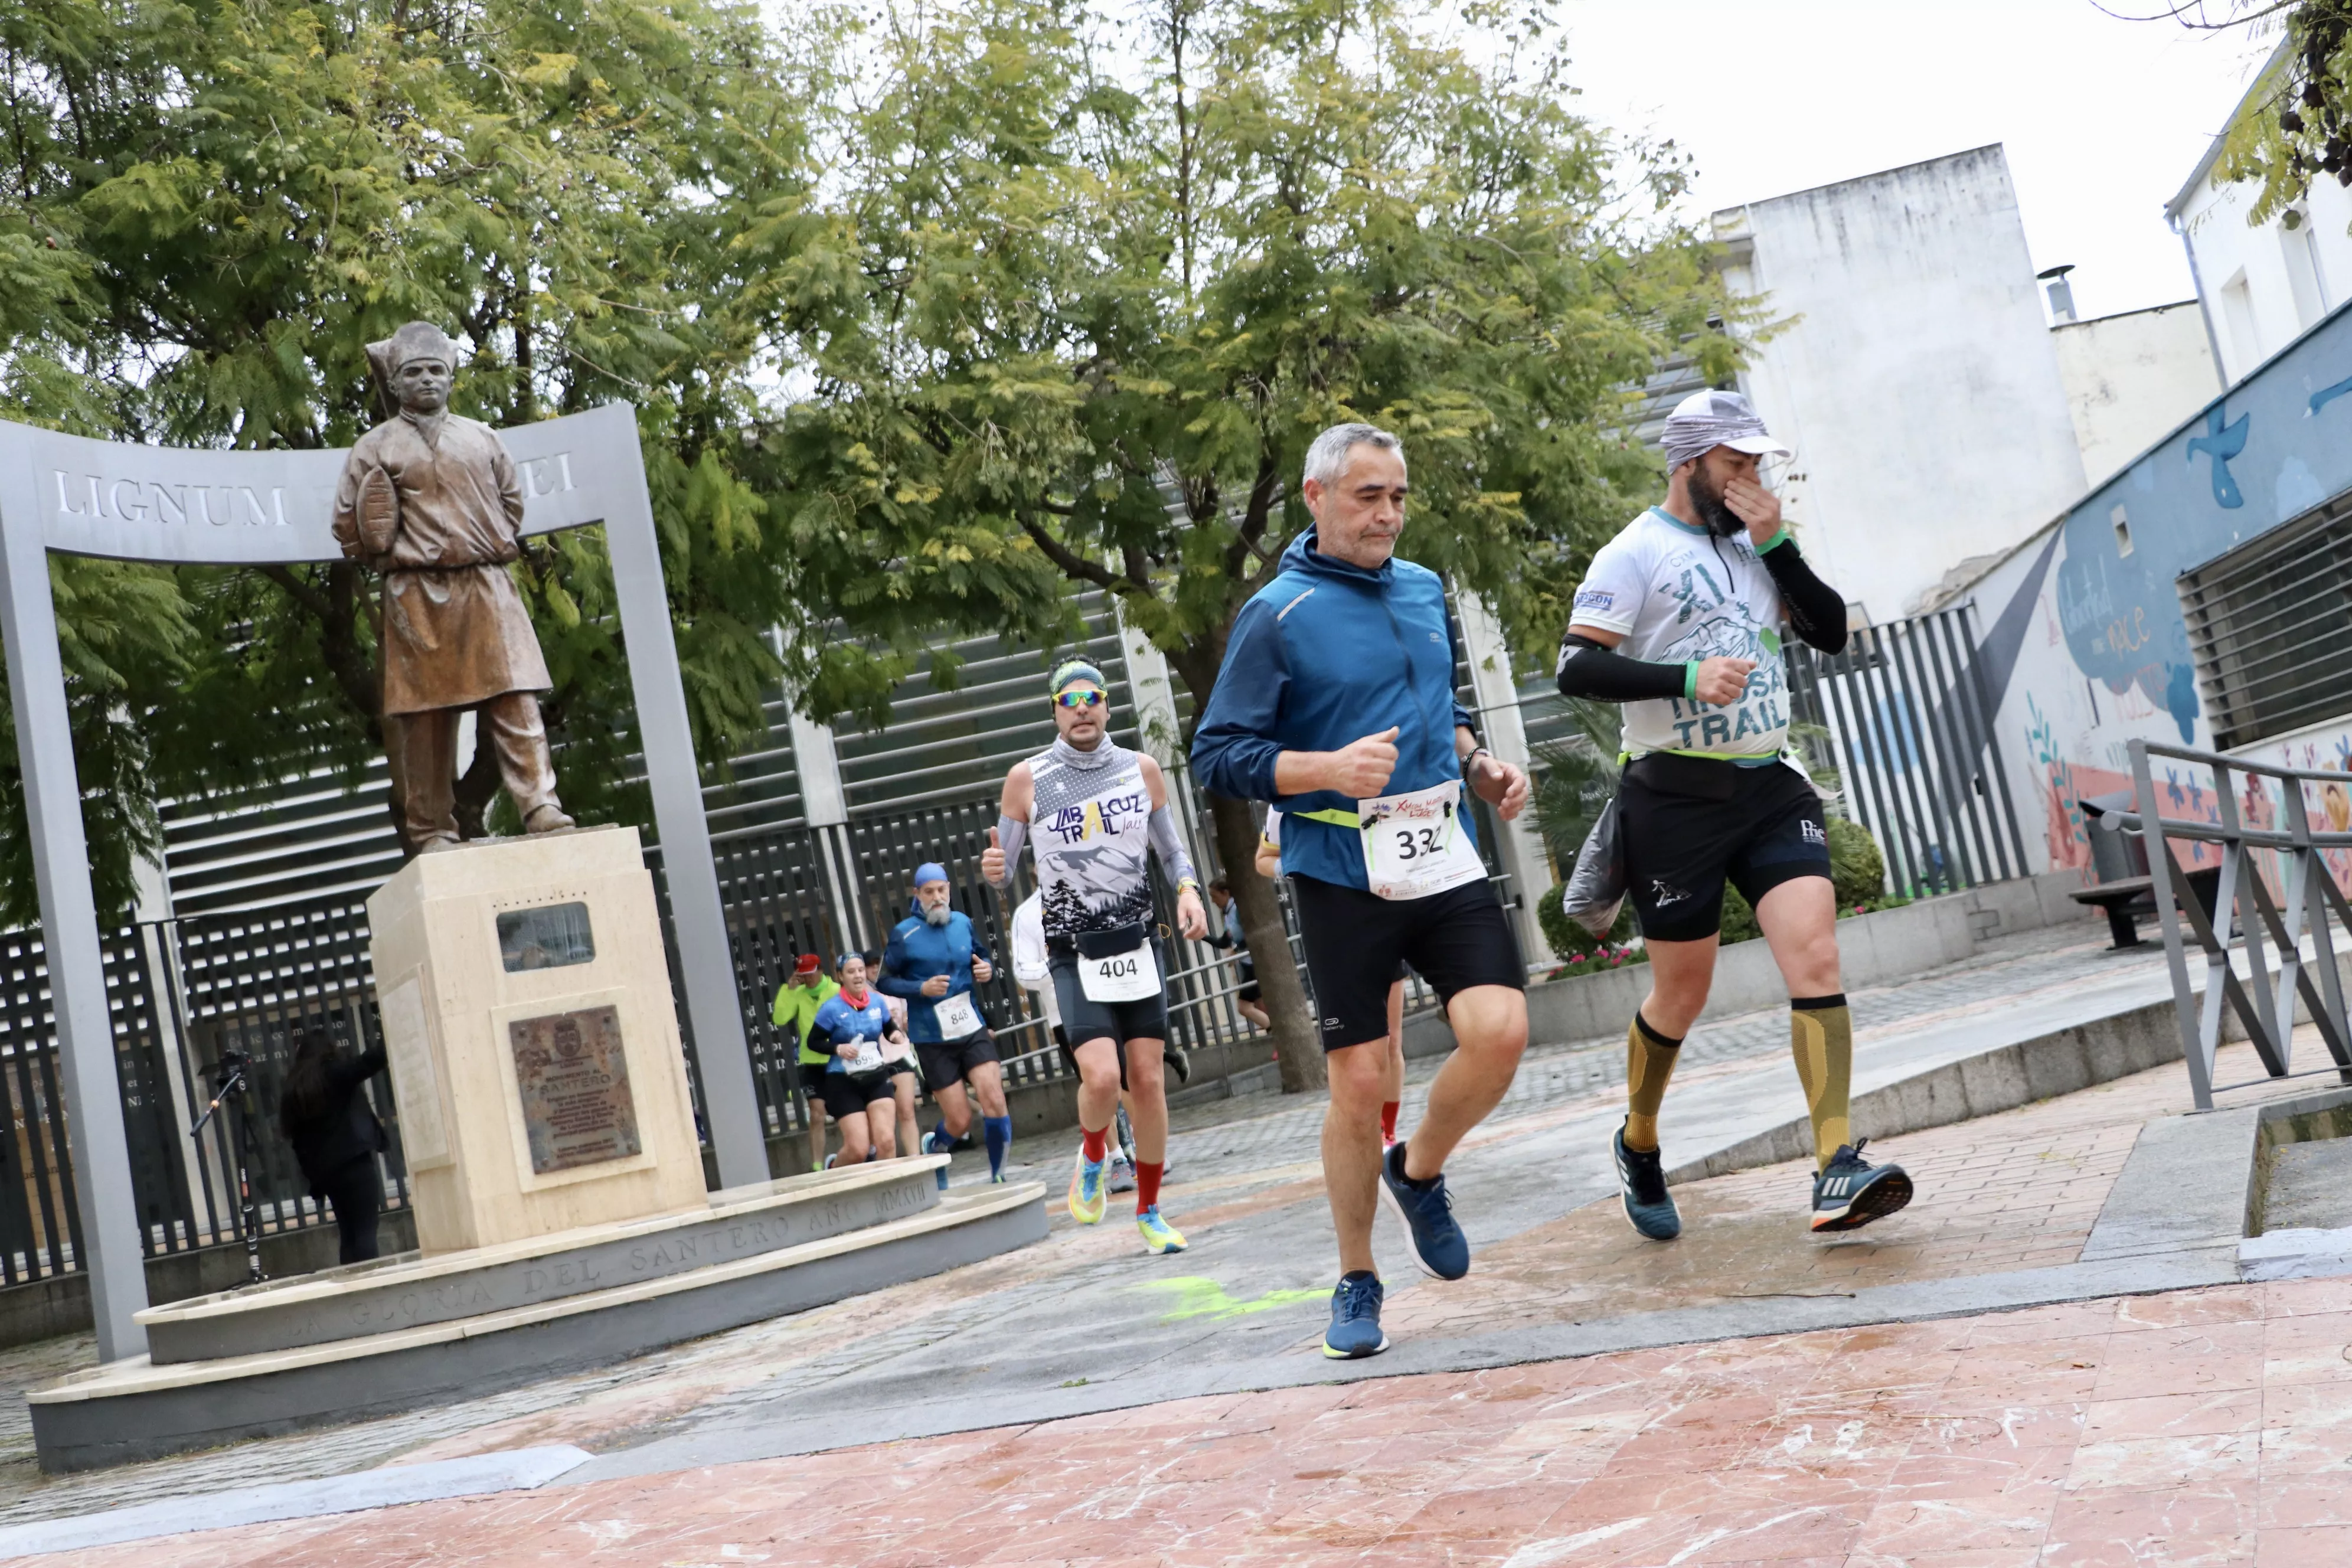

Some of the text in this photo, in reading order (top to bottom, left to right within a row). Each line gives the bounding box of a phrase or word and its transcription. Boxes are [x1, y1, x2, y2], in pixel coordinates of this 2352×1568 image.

[53, 469, 292, 526] LIGNUM
[519, 451, 578, 499] EI
[1672, 698, 1787, 749] TRAIL
[1057, 809, 1121, 844] TRAIL
[1396, 824, 1444, 860] 332
[1099, 958, 1139, 978] 404
[950, 1008, 969, 1025] 848
[854, 1054, 874, 1066] 699
[350, 1280, 494, 1326] GLORIA
[523, 1258, 601, 1295] DEL
[631, 1216, 790, 1271] SANTERO
